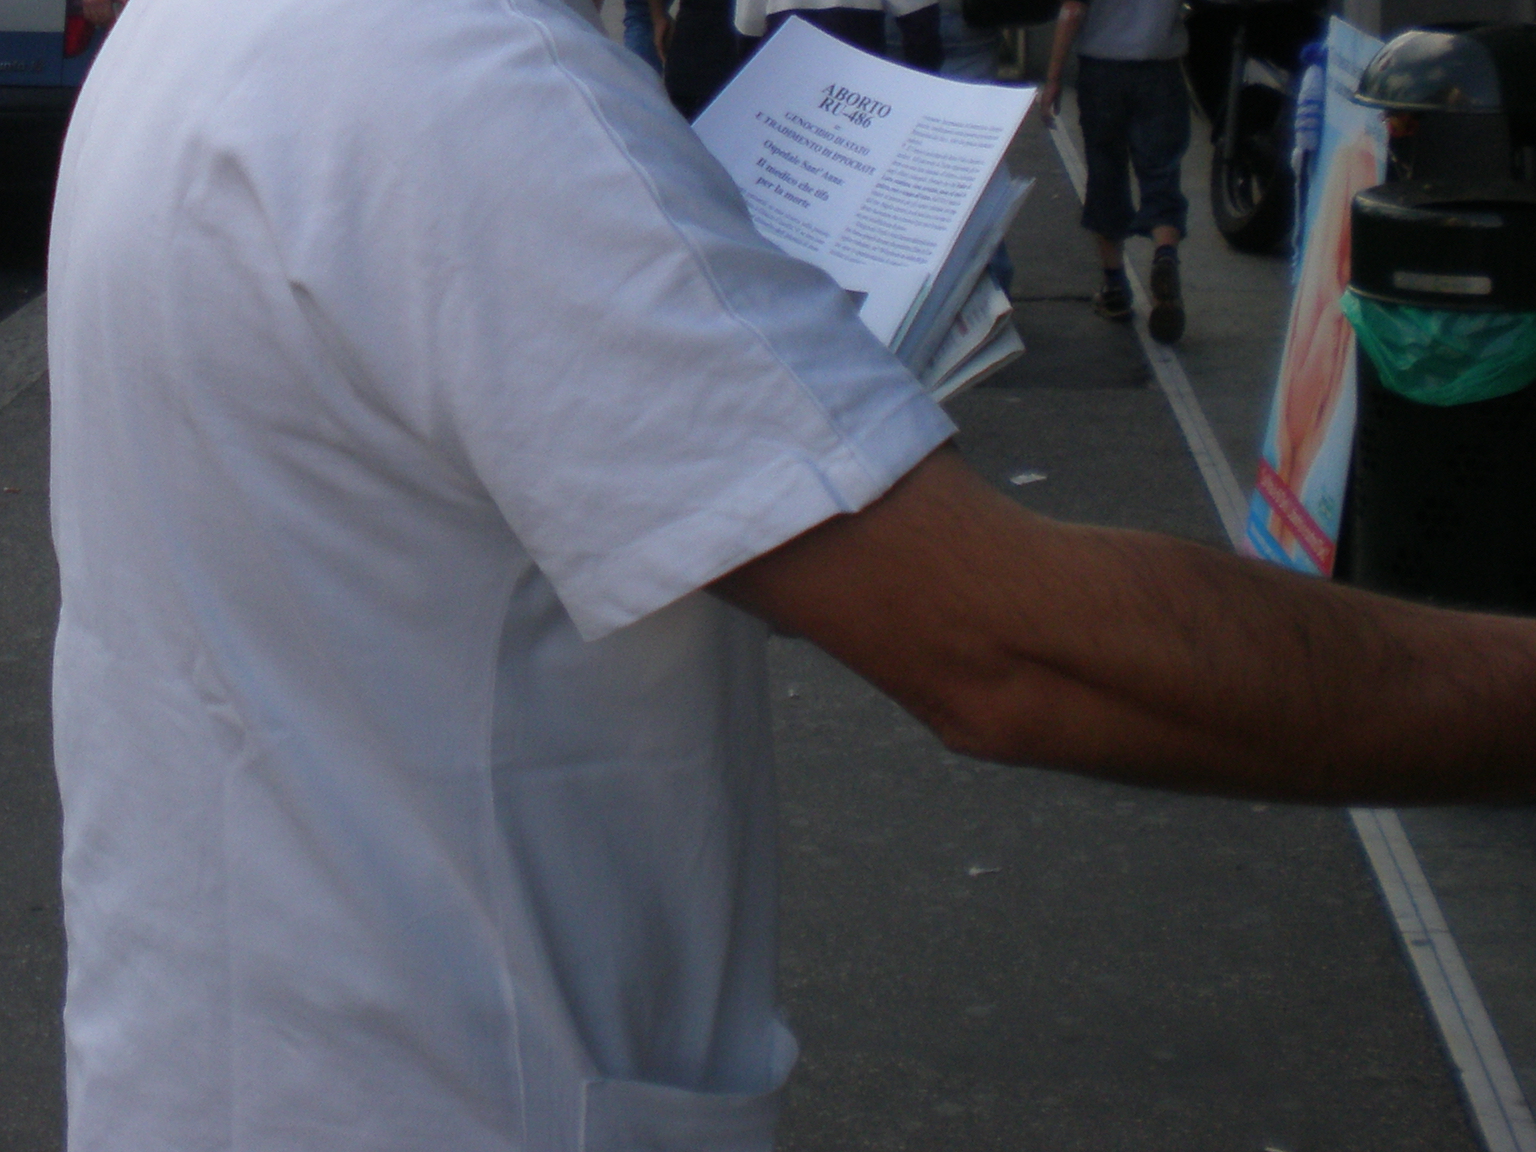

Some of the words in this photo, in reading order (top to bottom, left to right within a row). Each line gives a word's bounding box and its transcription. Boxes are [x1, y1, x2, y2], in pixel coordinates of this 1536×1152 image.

[818, 96, 873, 128] RU-486
[822, 83, 891, 118] ABORTO
[764, 116, 822, 152] TRADIMENTO
[785, 112, 834, 141] GENOCIDIO
[764, 139, 801, 165] Ospedale
[756, 176, 773, 189] per
[784, 192, 811, 208] morte
[765, 165, 798, 185] medico
[798, 181, 813, 194] che
